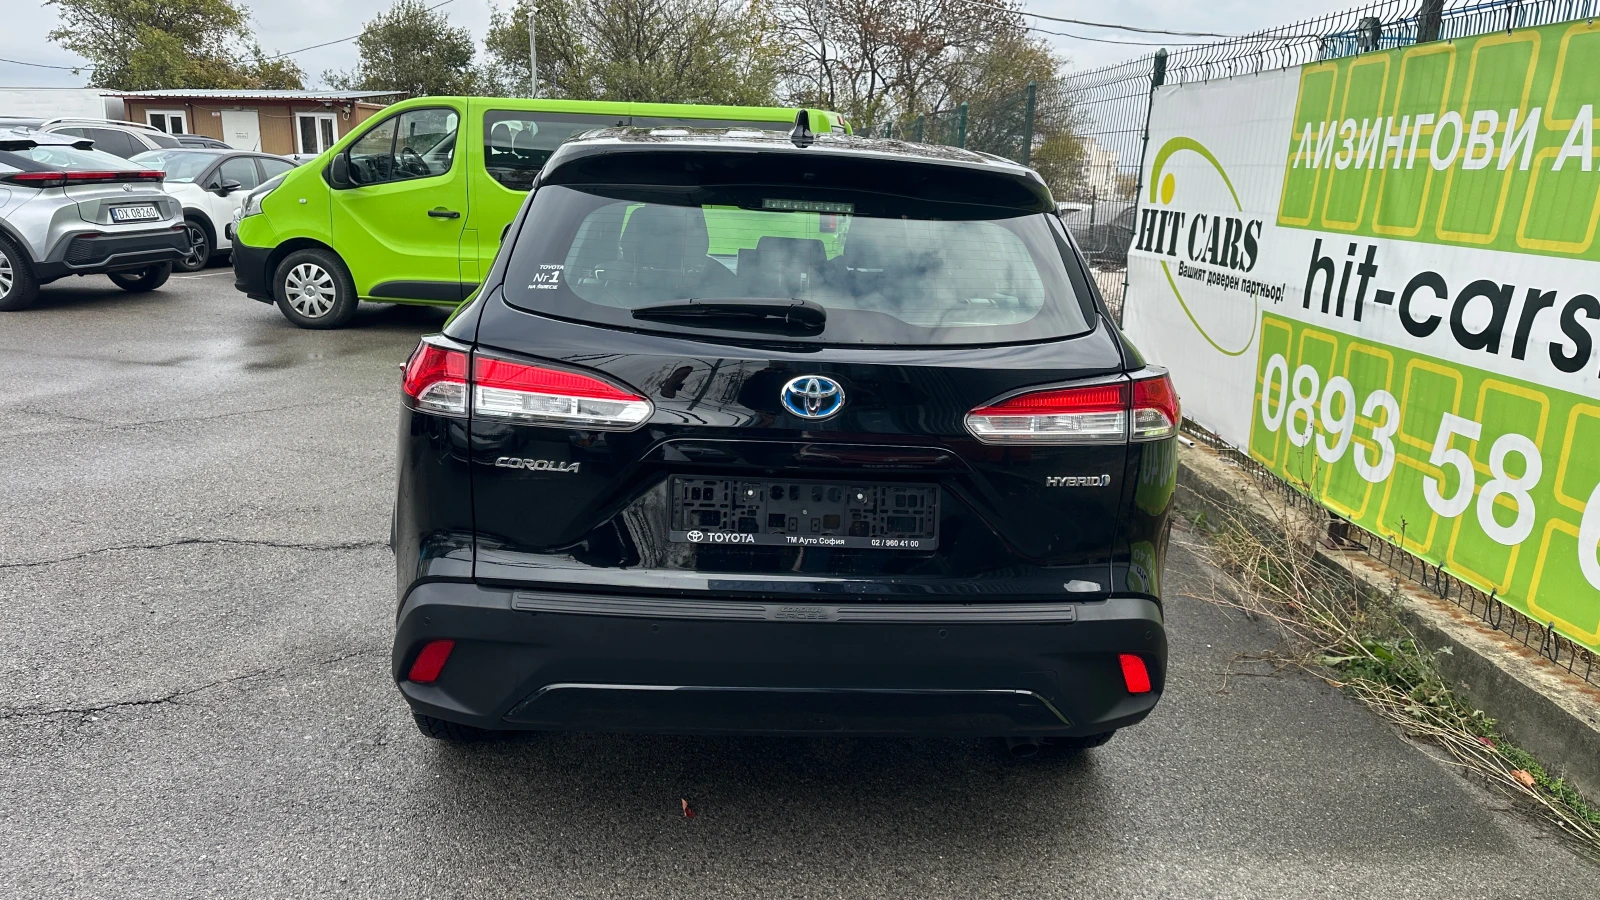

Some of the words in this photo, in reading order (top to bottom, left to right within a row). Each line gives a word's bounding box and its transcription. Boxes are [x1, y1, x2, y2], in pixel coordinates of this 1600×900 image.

[1293, 107, 1542, 171] ЛИЗИНГОВИ
[1551, 104, 1600, 171] А
[118, 208, 130, 219] DX
[131, 207, 156, 218] 08260
[1135, 208, 1186, 256] HIT
[1187, 212, 1263, 273] CARS
[533, 272, 549, 282] Nr
[549, 270, 559, 282] 1
[1178, 260, 1206, 282] Вашият
[1206, 271, 1240, 291] доверен
[1240, 278, 1286, 304] партньор!
[1303, 238, 1600, 379] hit-cars
[1261, 353, 1400, 483] 0893
[1423, 412, 1543, 546] 58
[494, 456, 581, 474] COROLLA
[1046, 476, 1101, 487] HYBRID
[707, 532, 755, 543] TOYOTA
[798, 536, 818, 545] Ауто
[819, 537, 845, 546] София
